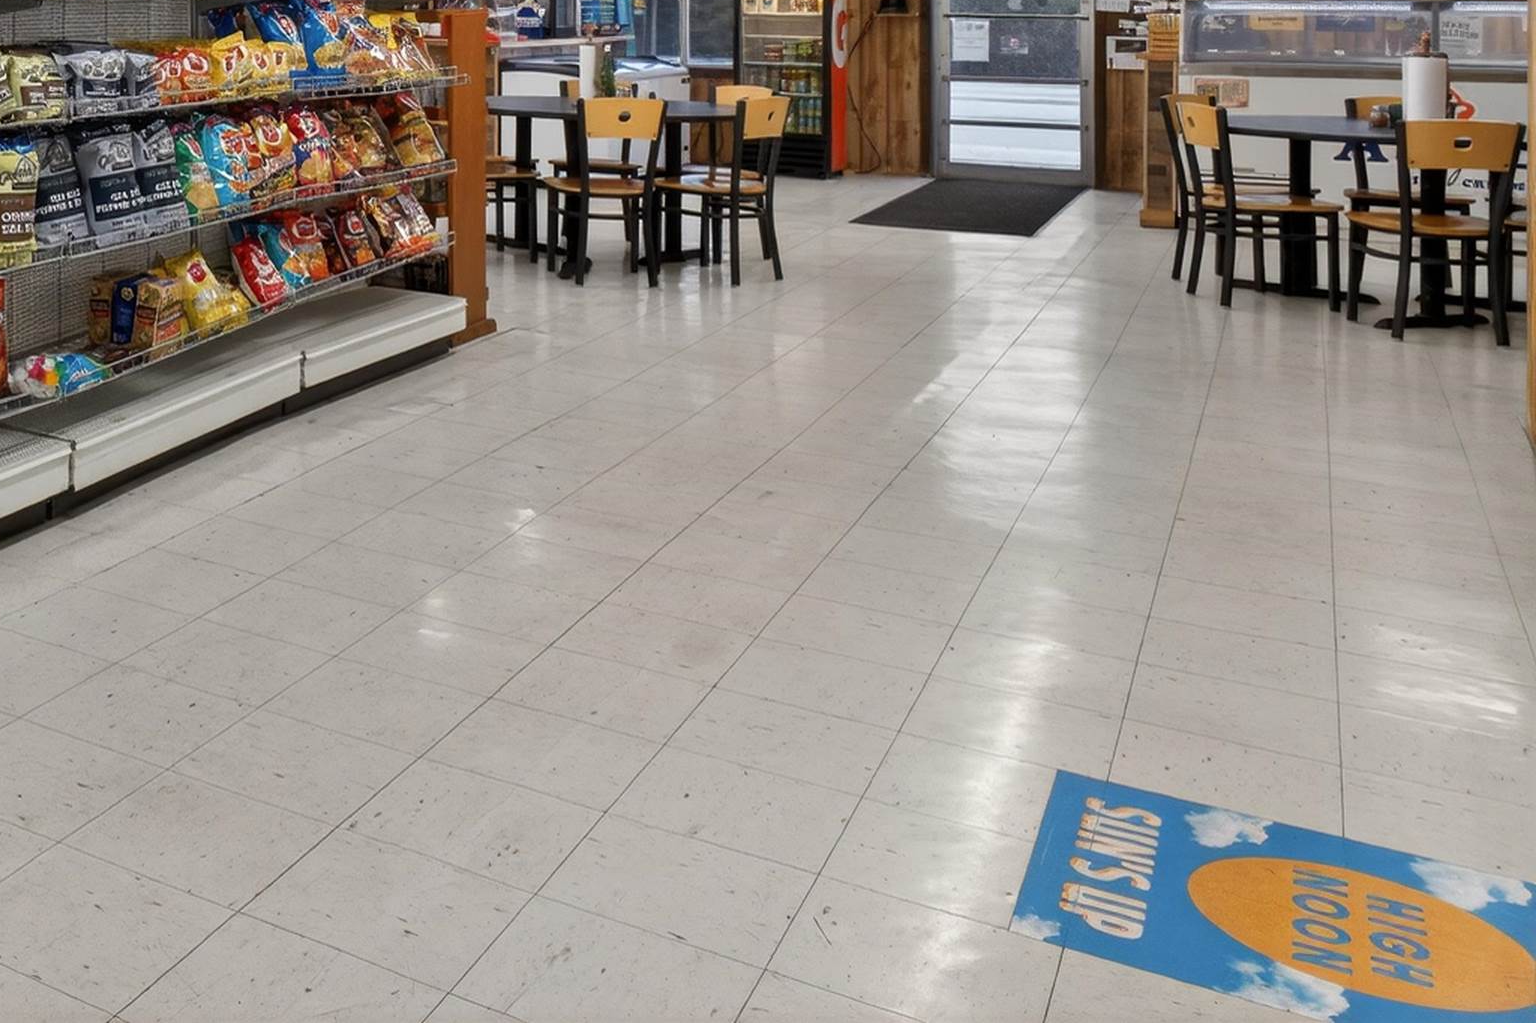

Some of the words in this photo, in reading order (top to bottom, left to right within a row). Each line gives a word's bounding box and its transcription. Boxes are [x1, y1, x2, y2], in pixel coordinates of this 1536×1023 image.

[1068, 796, 1162, 892] SUN'S
[1058, 881, 1148, 940] UP
[1291, 867, 1353, 976] NOON
[1366, 894, 1434, 988] HIGH
